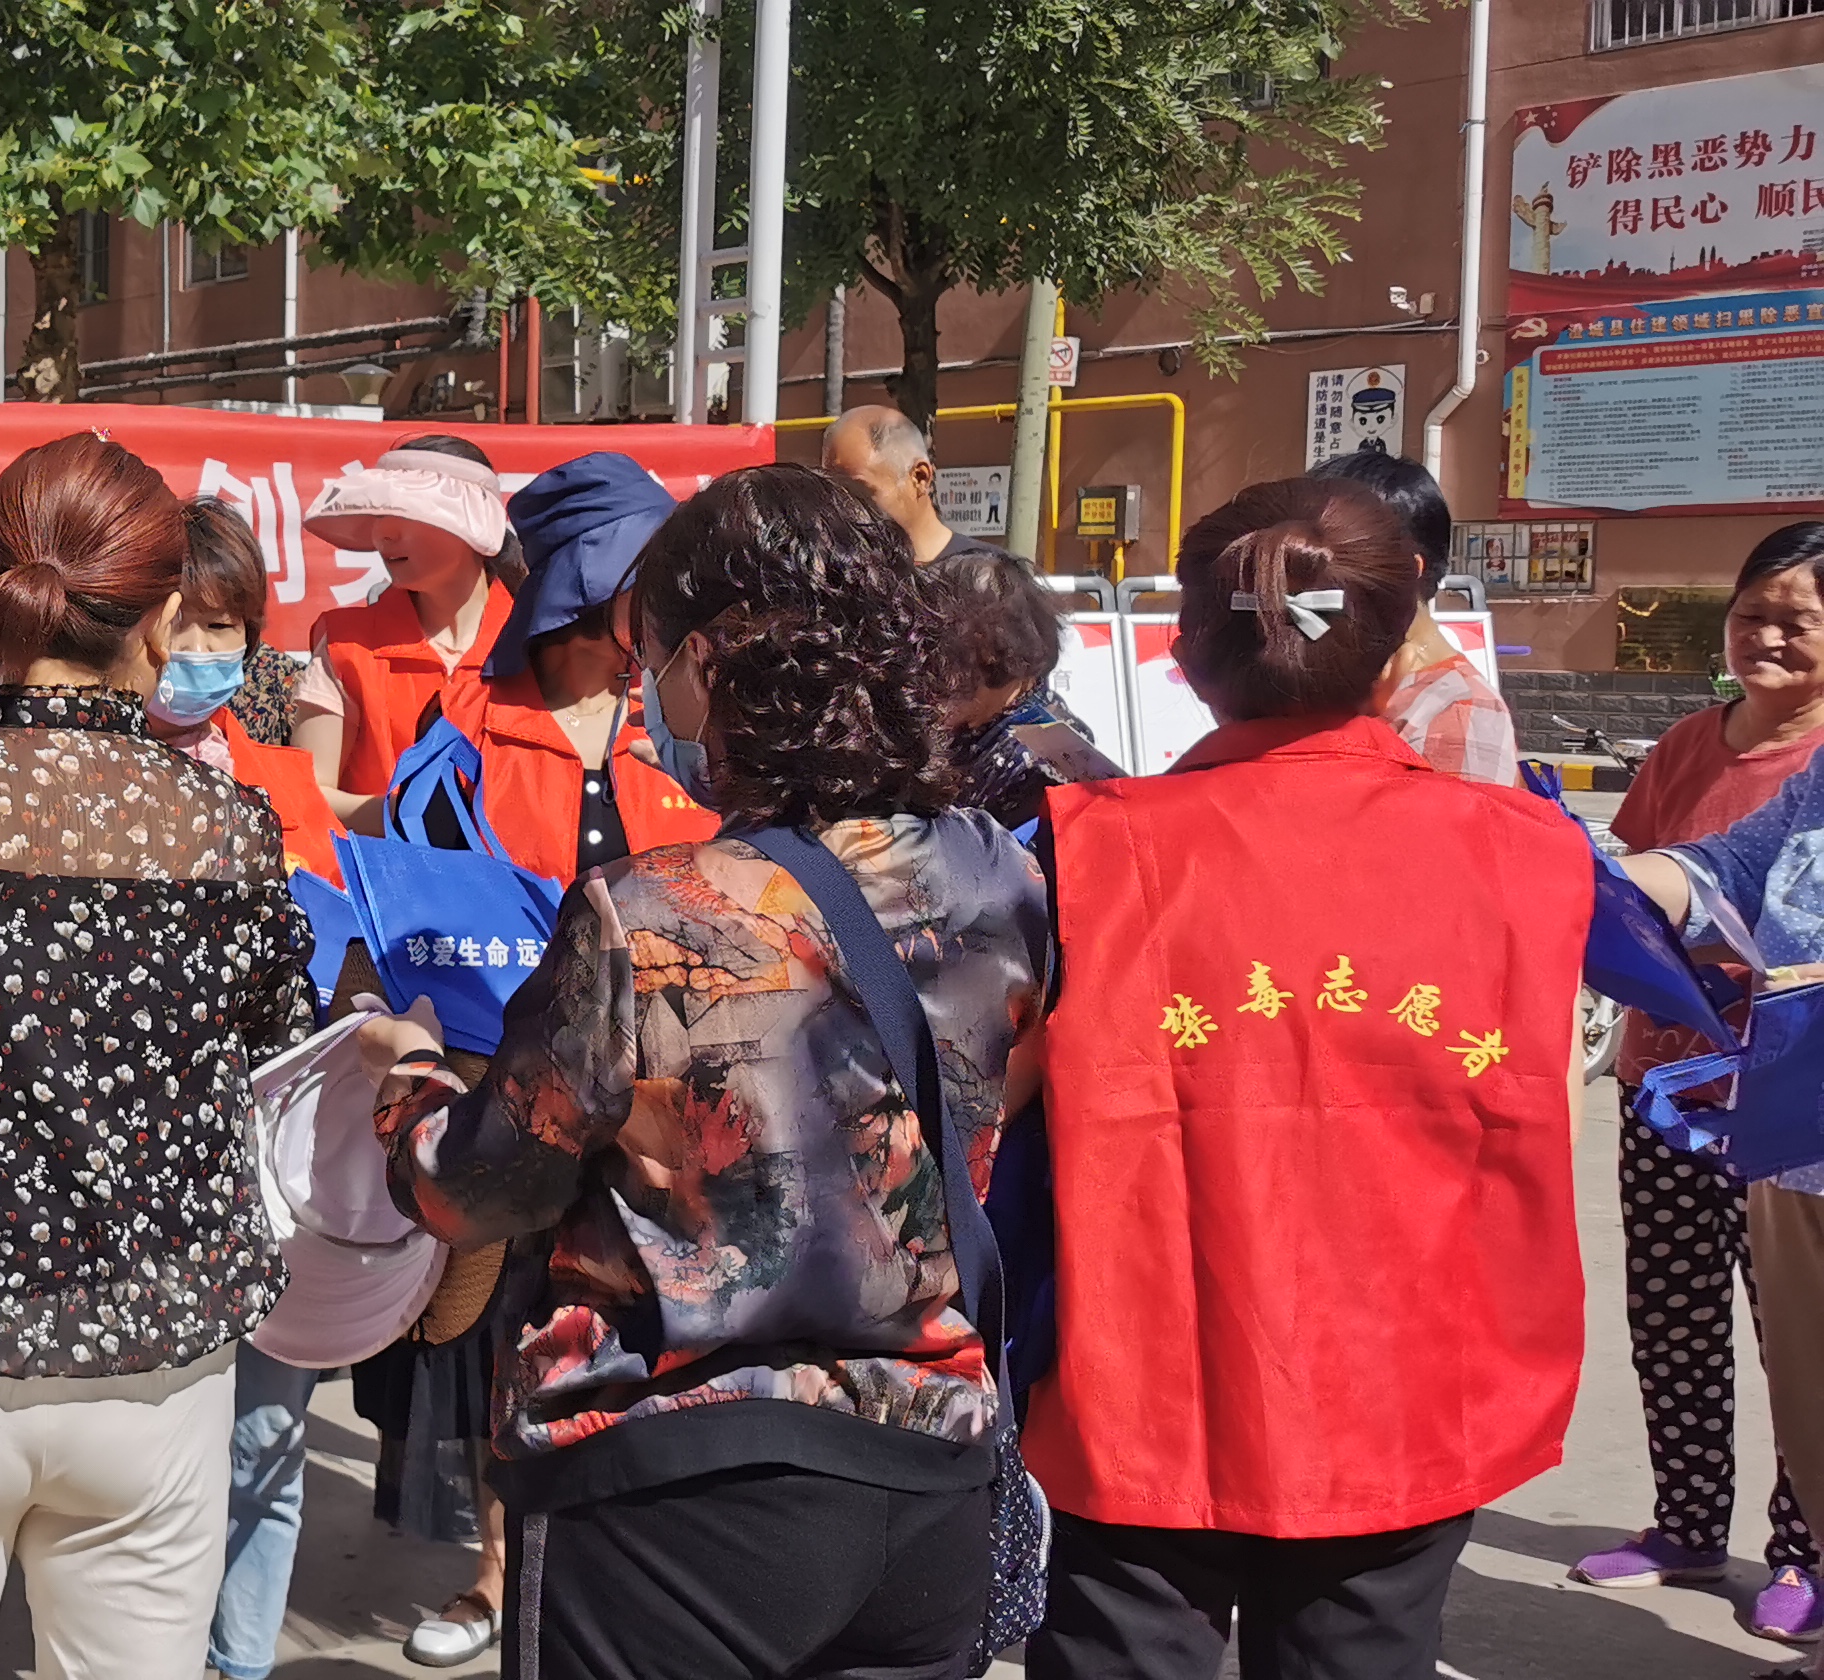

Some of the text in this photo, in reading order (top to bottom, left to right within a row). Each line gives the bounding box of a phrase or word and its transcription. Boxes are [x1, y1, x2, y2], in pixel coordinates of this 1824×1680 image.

[1566, 124, 1817, 190] 铲除黑恶势力
[1607, 192, 1729, 237] 得民心
[1053, 668, 1073, 692] 育
[406, 936, 510, 969] 珍爱生命
[1158, 954, 1509, 1078] 禁毒志愿者
